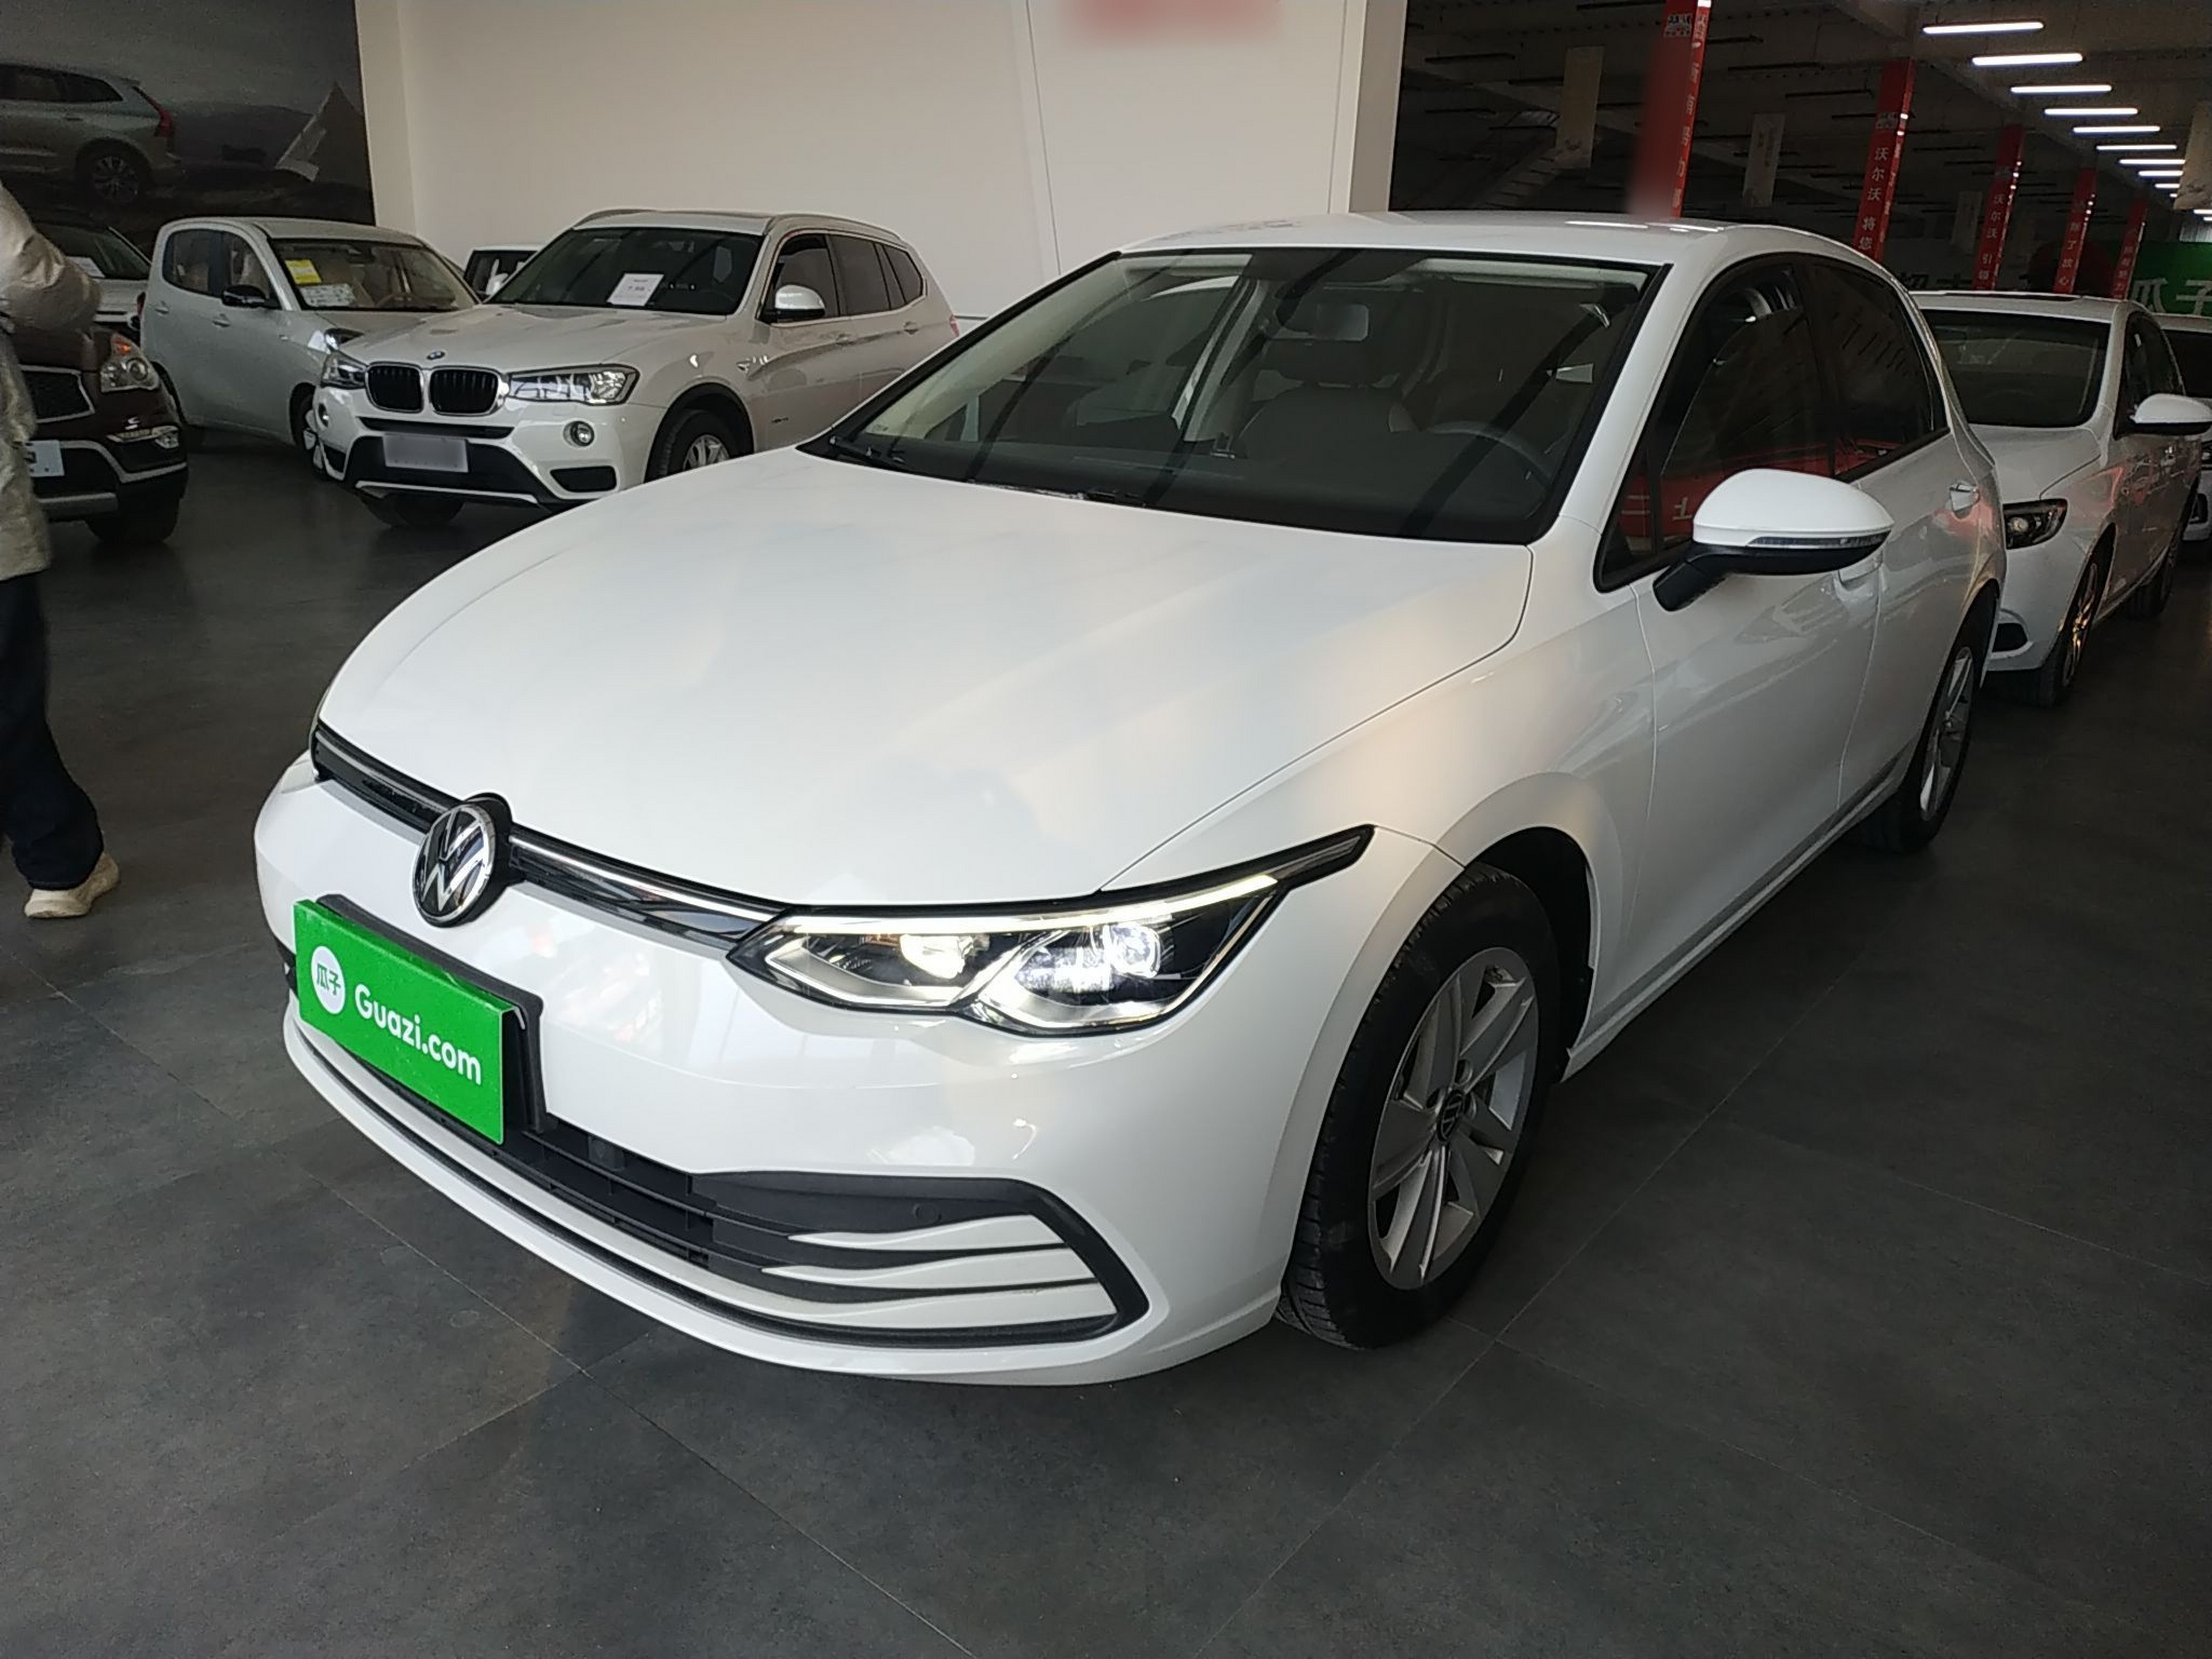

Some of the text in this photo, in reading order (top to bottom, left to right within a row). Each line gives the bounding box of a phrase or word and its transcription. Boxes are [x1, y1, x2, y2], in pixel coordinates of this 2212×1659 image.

[1868, 146, 1889, 200] 沃尔沃
[317, 963, 482, 1086] 瓜子 Guazi.com
